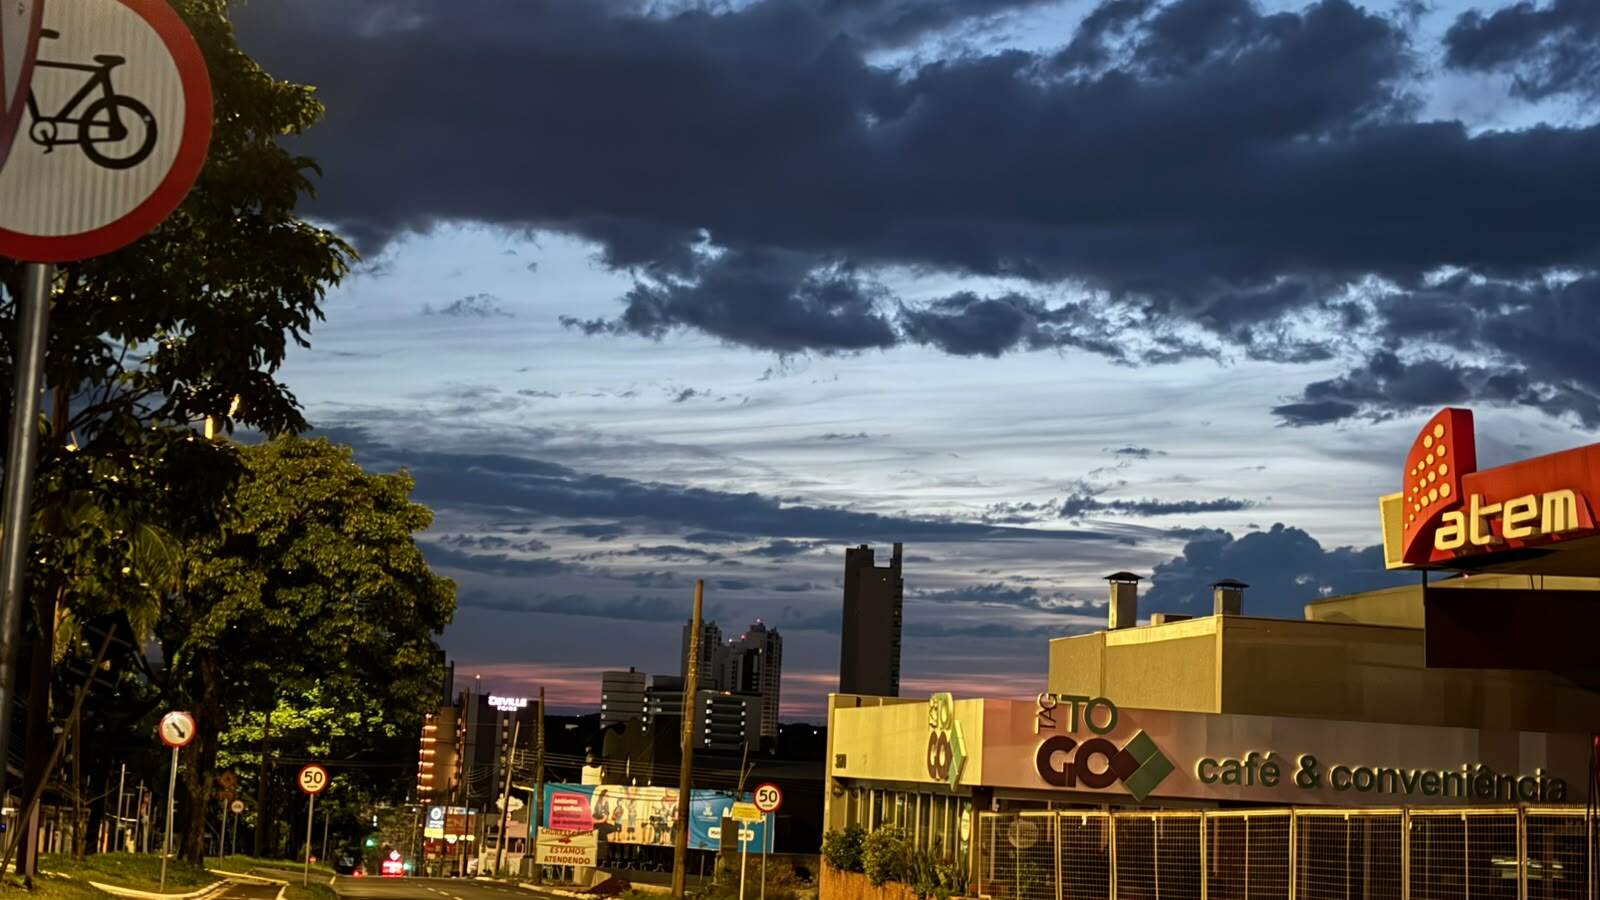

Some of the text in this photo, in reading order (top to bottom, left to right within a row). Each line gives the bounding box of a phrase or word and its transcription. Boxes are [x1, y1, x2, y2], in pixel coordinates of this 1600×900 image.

[1434, 488, 1580, 551] atem
[488, 695, 528, 707] DEVILLE
[1059, 693, 1119, 736] TO
[1035, 735, 1123, 790] GO
[304, 771, 323, 784] 50
[1195, 751, 1568, 803] café & conveniência
[759, 789, 778, 803] 50
[550, 847, 586, 855] ESTAMOS
[544, 856, 591, 865] ATENDENDO
